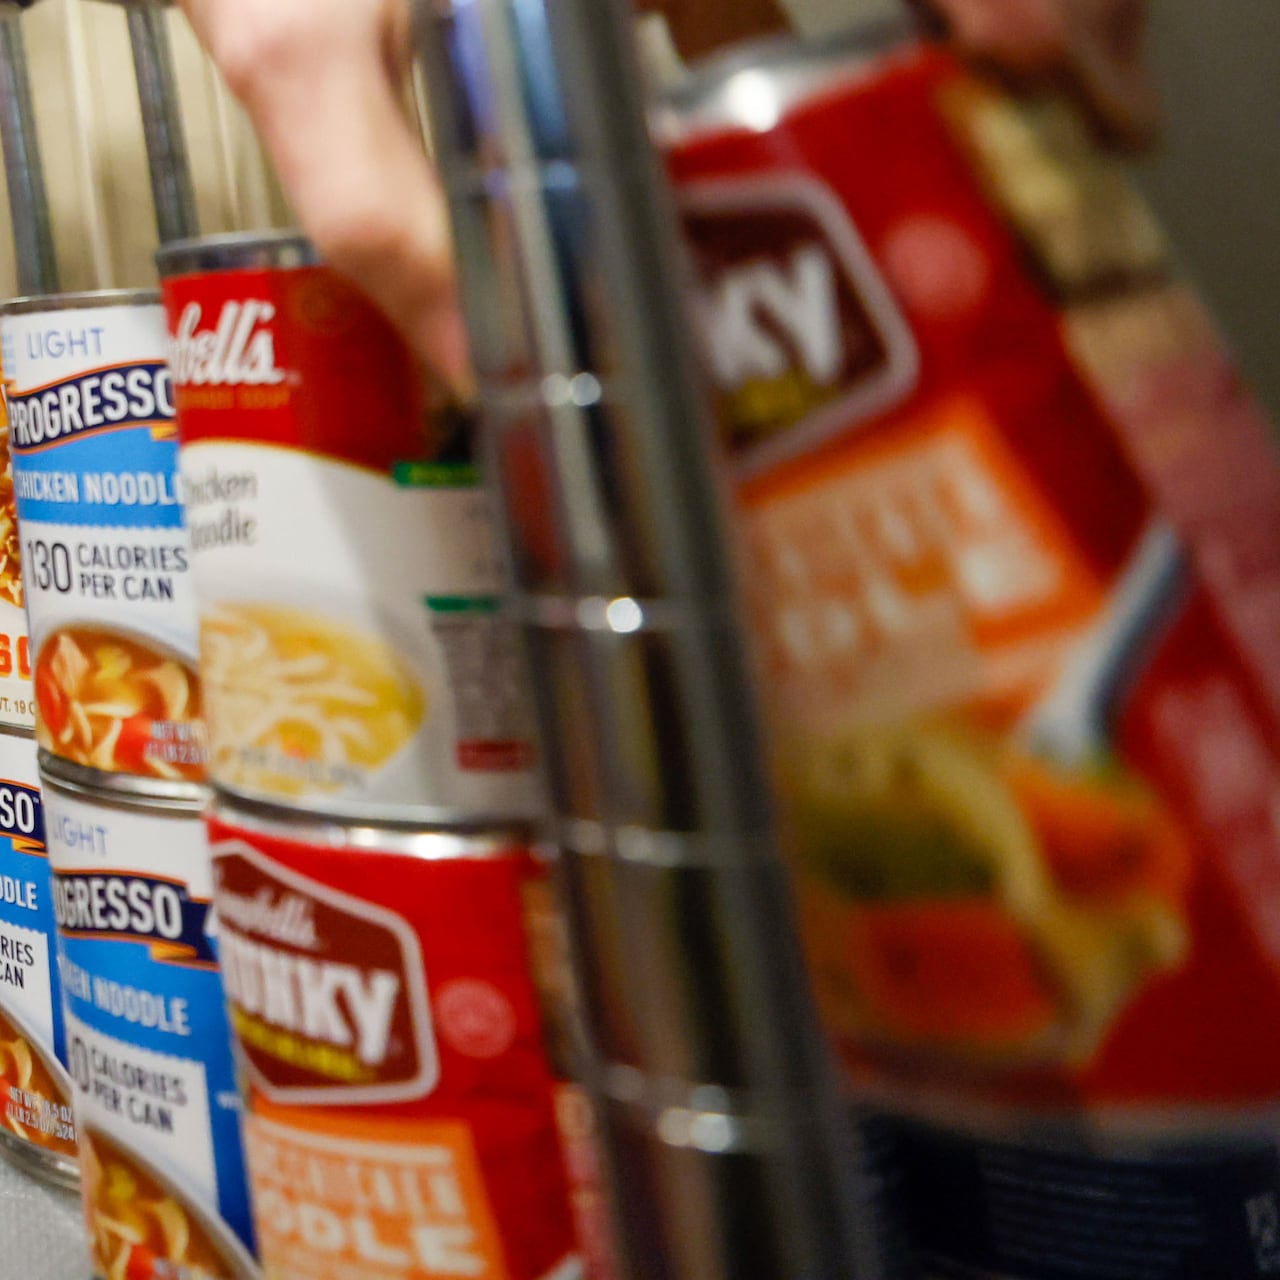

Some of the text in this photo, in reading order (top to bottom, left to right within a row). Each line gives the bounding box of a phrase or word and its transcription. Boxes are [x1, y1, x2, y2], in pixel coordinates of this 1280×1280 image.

[28, 327, 104, 359] LIGHT
[85, 472, 182, 506] NOODL
[27, 540, 189, 593] 130 CALORIES
[79, 573, 175, 602] PER CAN
[14, 700, 26, 714] 19
[56, 874, 183, 940] OGRESSO
[94, 975, 190, 1036] NOODLE
[91, 1048, 188, 1108] CALORIES
[94, 1081, 122, 1115] PER
[129, 1094, 175, 1134] CAN
